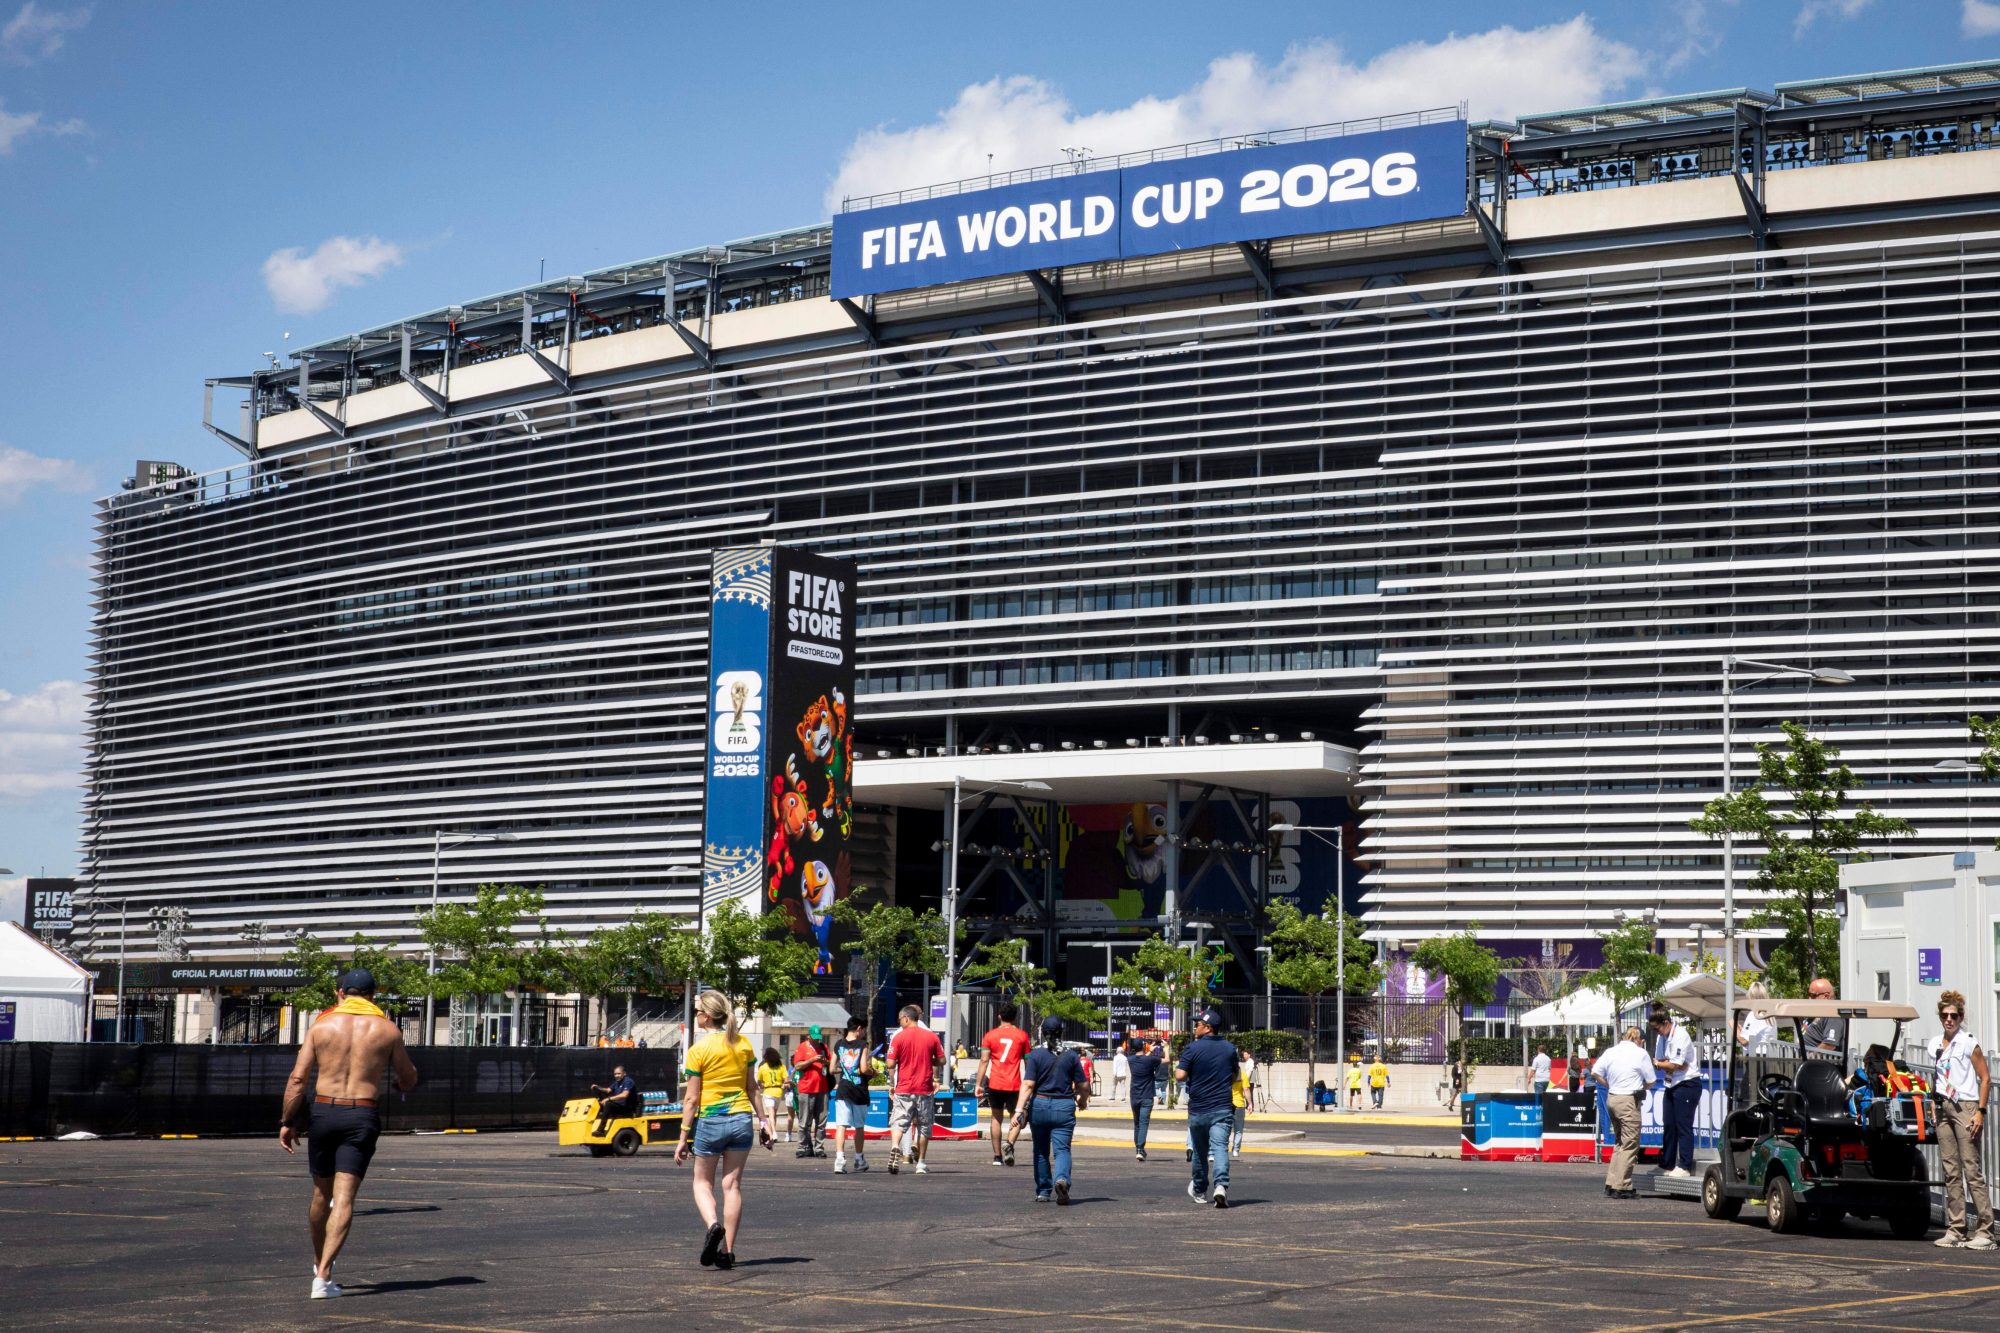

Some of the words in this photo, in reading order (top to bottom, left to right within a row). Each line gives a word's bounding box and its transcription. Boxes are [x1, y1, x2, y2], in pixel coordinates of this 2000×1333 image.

[862, 220, 946, 269] FIFA
[957, 195, 1115, 254] WORLD
[1131, 177, 1224, 228] CUP
[1240, 152, 1418, 214] 2026
[788, 607, 841, 641] STORE
[790, 644, 840, 661] FIFASTORE.COM
[728, 736, 748, 745] FIFA
[714, 755, 742, 764] WORLD
[743, 755, 760, 763] CUP
[713, 763, 760, 777] 2026
[34, 891, 73, 907] FIFA
[34, 907, 73, 918] STORE
[172, 969, 208, 978] OFFICIAL
[209, 968, 248, 978] PLAYLIST
[249, 968, 266, 977] FIFA
[266, 968, 294, 977] WORLD
[1072, 987, 1089, 996] FIFA
[1000, 1037, 1013, 1063] 7
